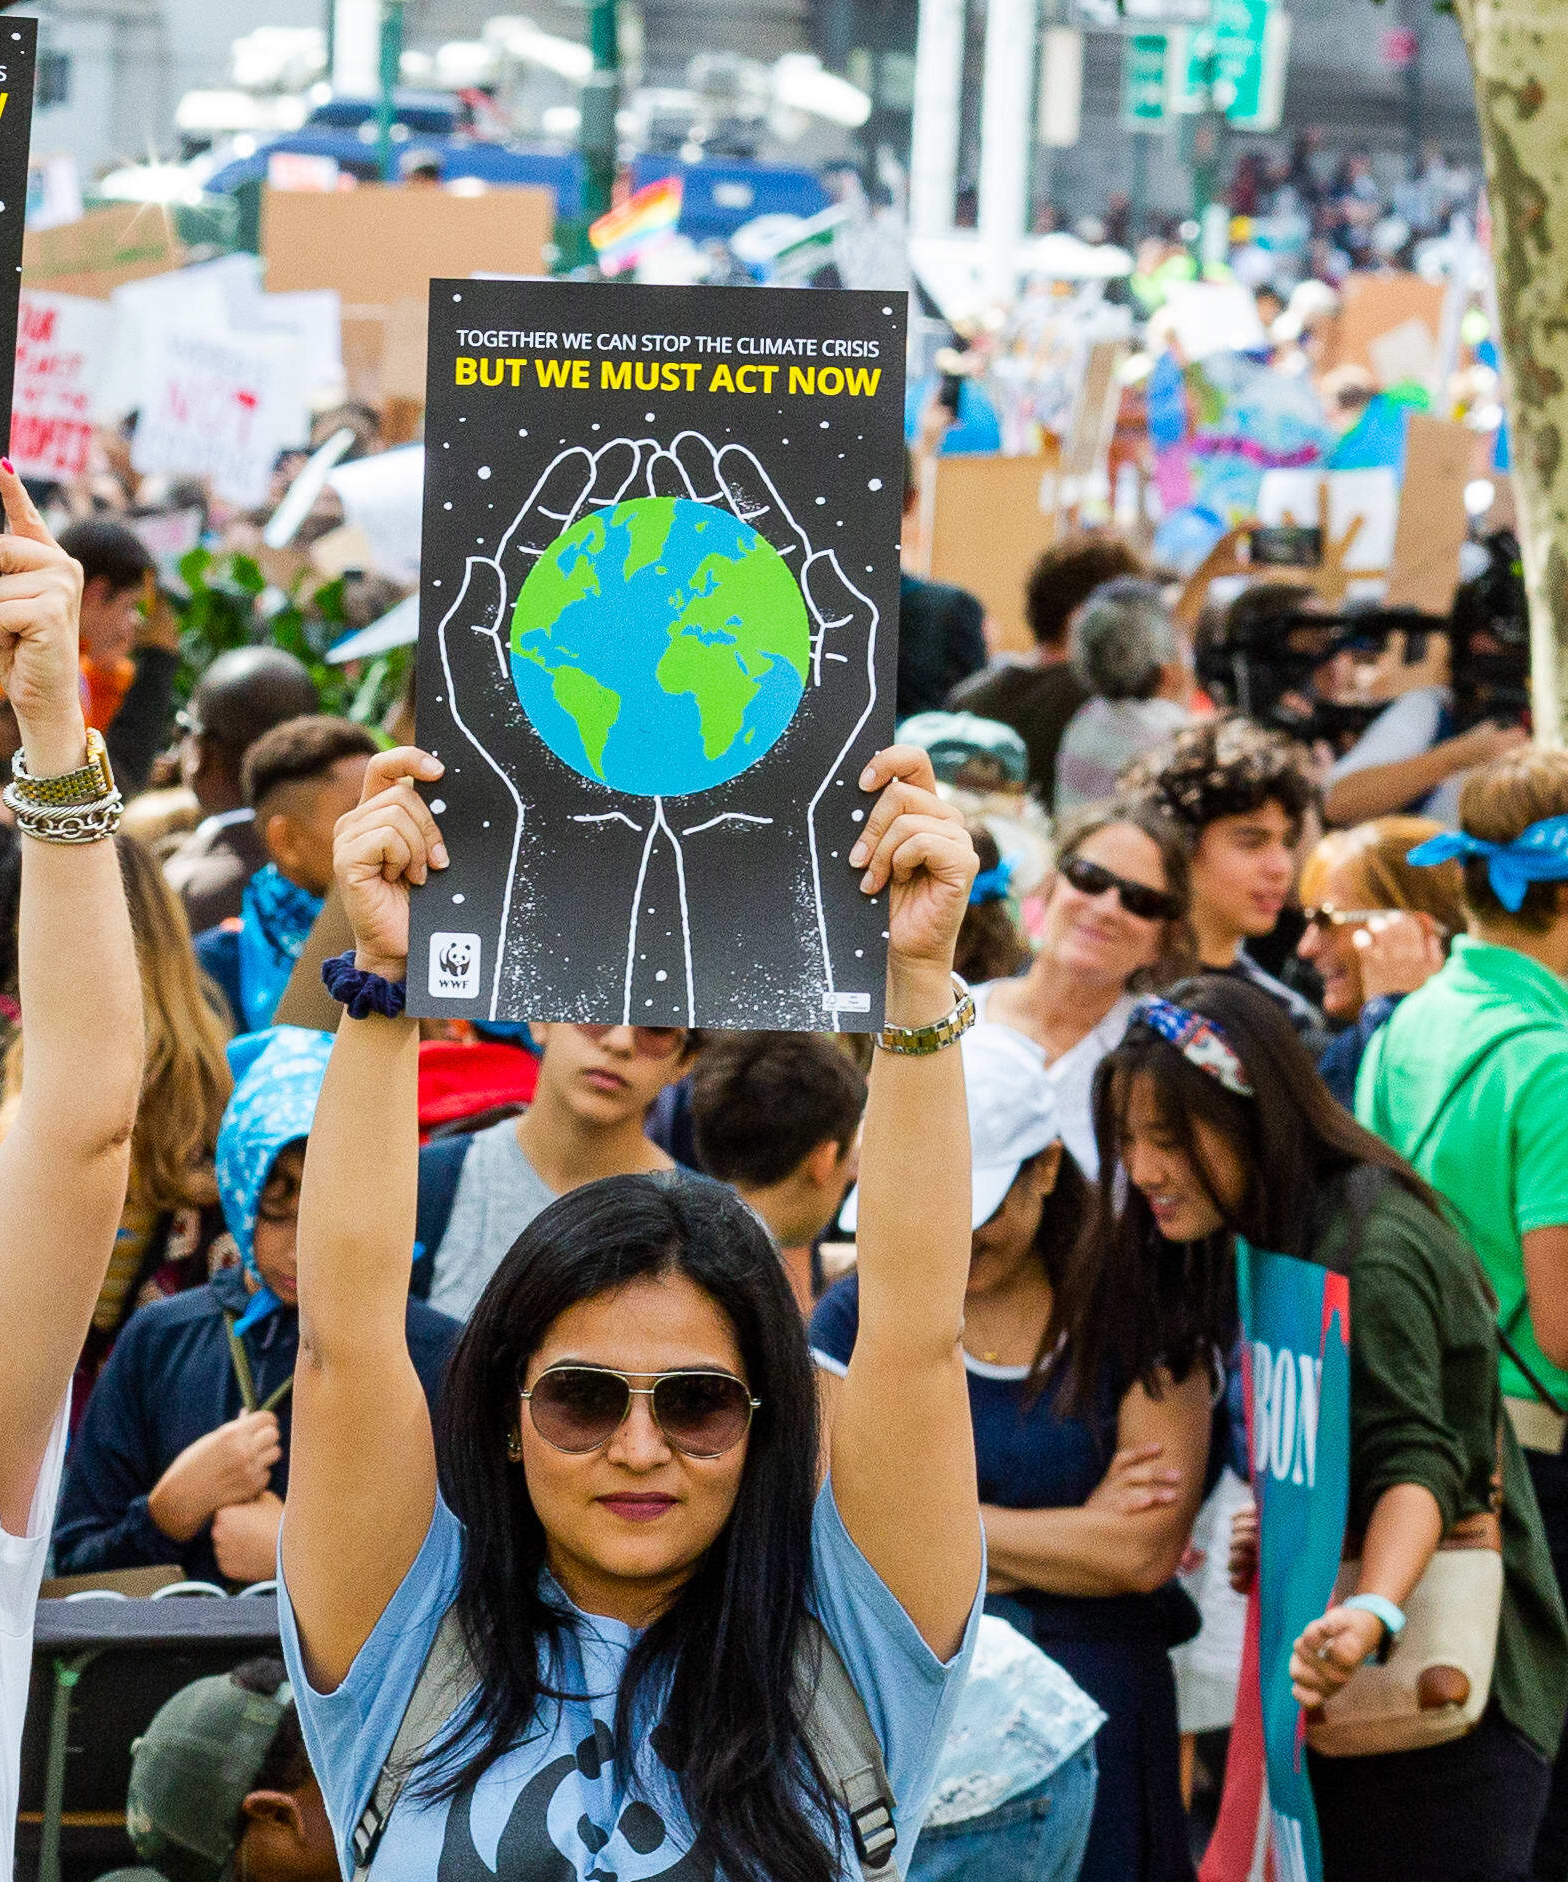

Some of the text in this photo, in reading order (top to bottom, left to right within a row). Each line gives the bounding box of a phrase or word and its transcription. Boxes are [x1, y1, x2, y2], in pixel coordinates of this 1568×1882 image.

[456, 330, 879, 357] TOGETHER WE CAN STOP THE CLIMATE CRISIS
[456, 357, 881, 396] BUT WE MUST ACT NOW
[439, 979, 469, 990] WWF
